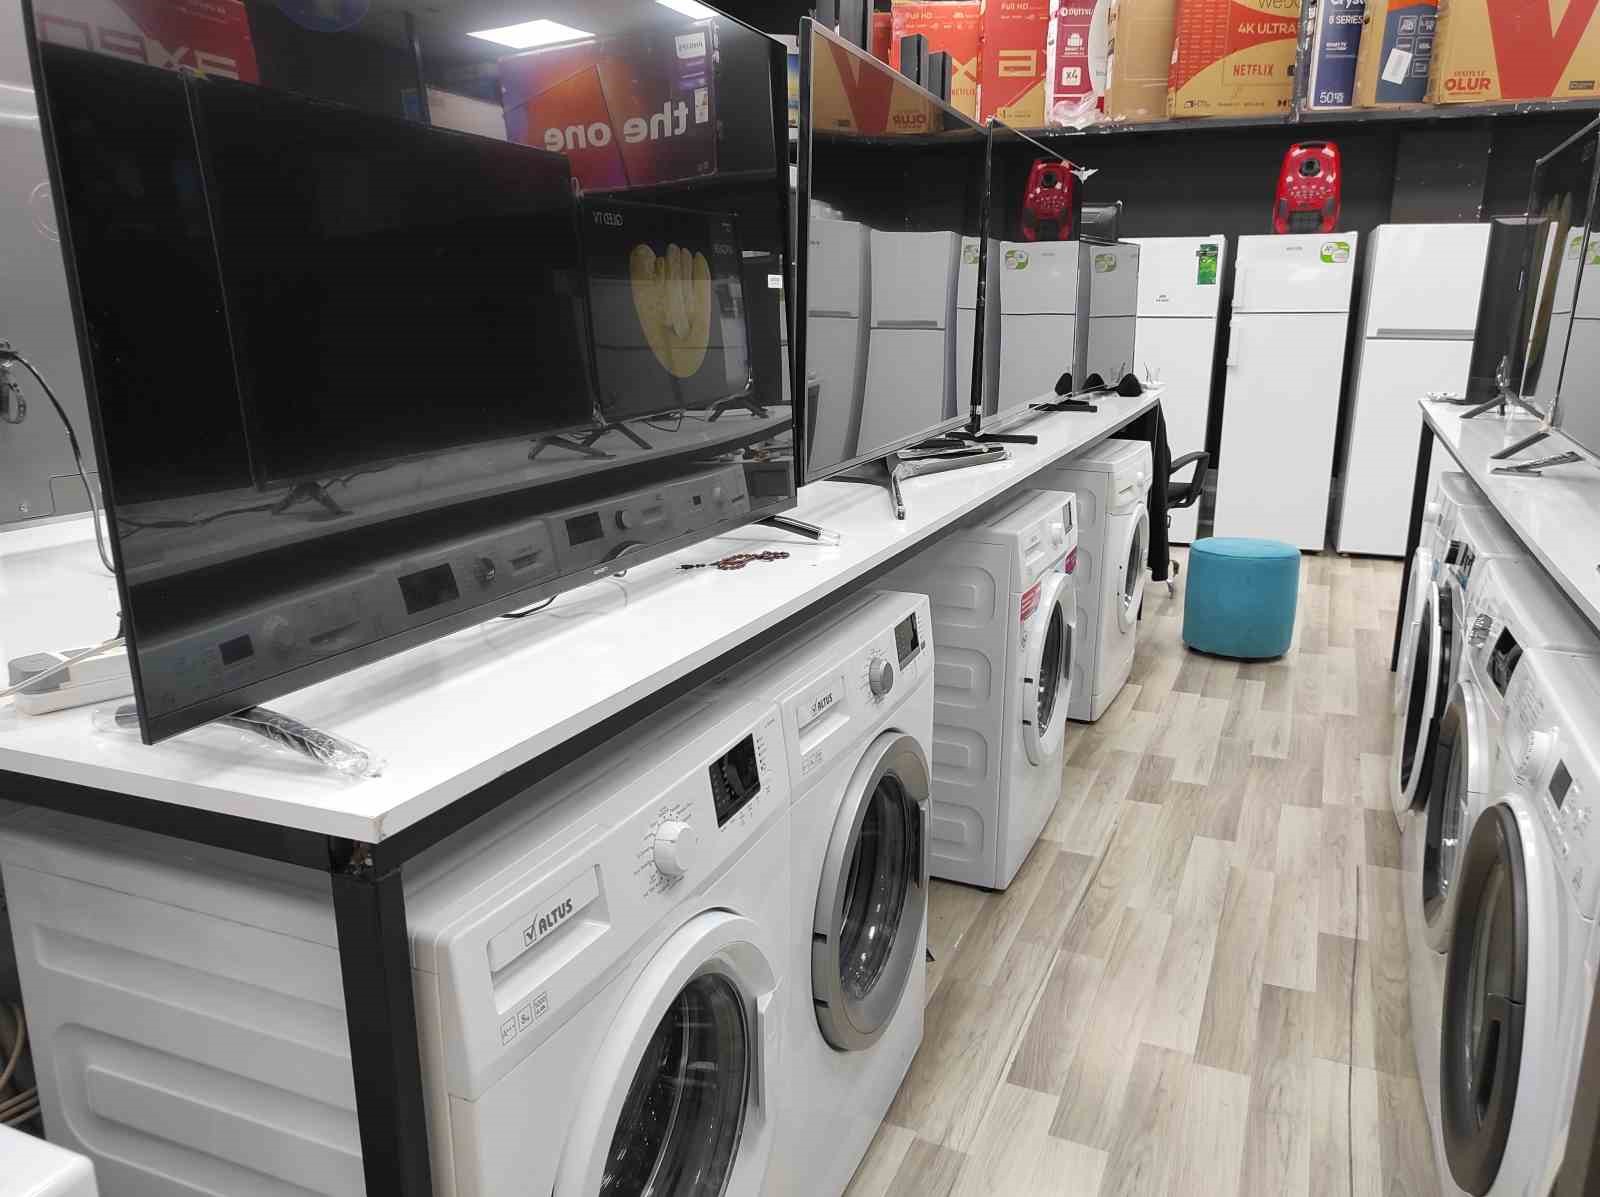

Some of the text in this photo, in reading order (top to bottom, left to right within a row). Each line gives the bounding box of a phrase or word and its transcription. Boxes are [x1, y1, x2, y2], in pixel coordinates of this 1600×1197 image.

[1238, 23, 1296, 34] 4K ULTRA
[1233, 63, 1275, 77] NETFLIX
[1444, 77, 1491, 91] OLUR
[1319, 91, 1334, 104] 50
[818, 692, 833, 712] ALTUS
[538, 897, 573, 935] ALTUS
